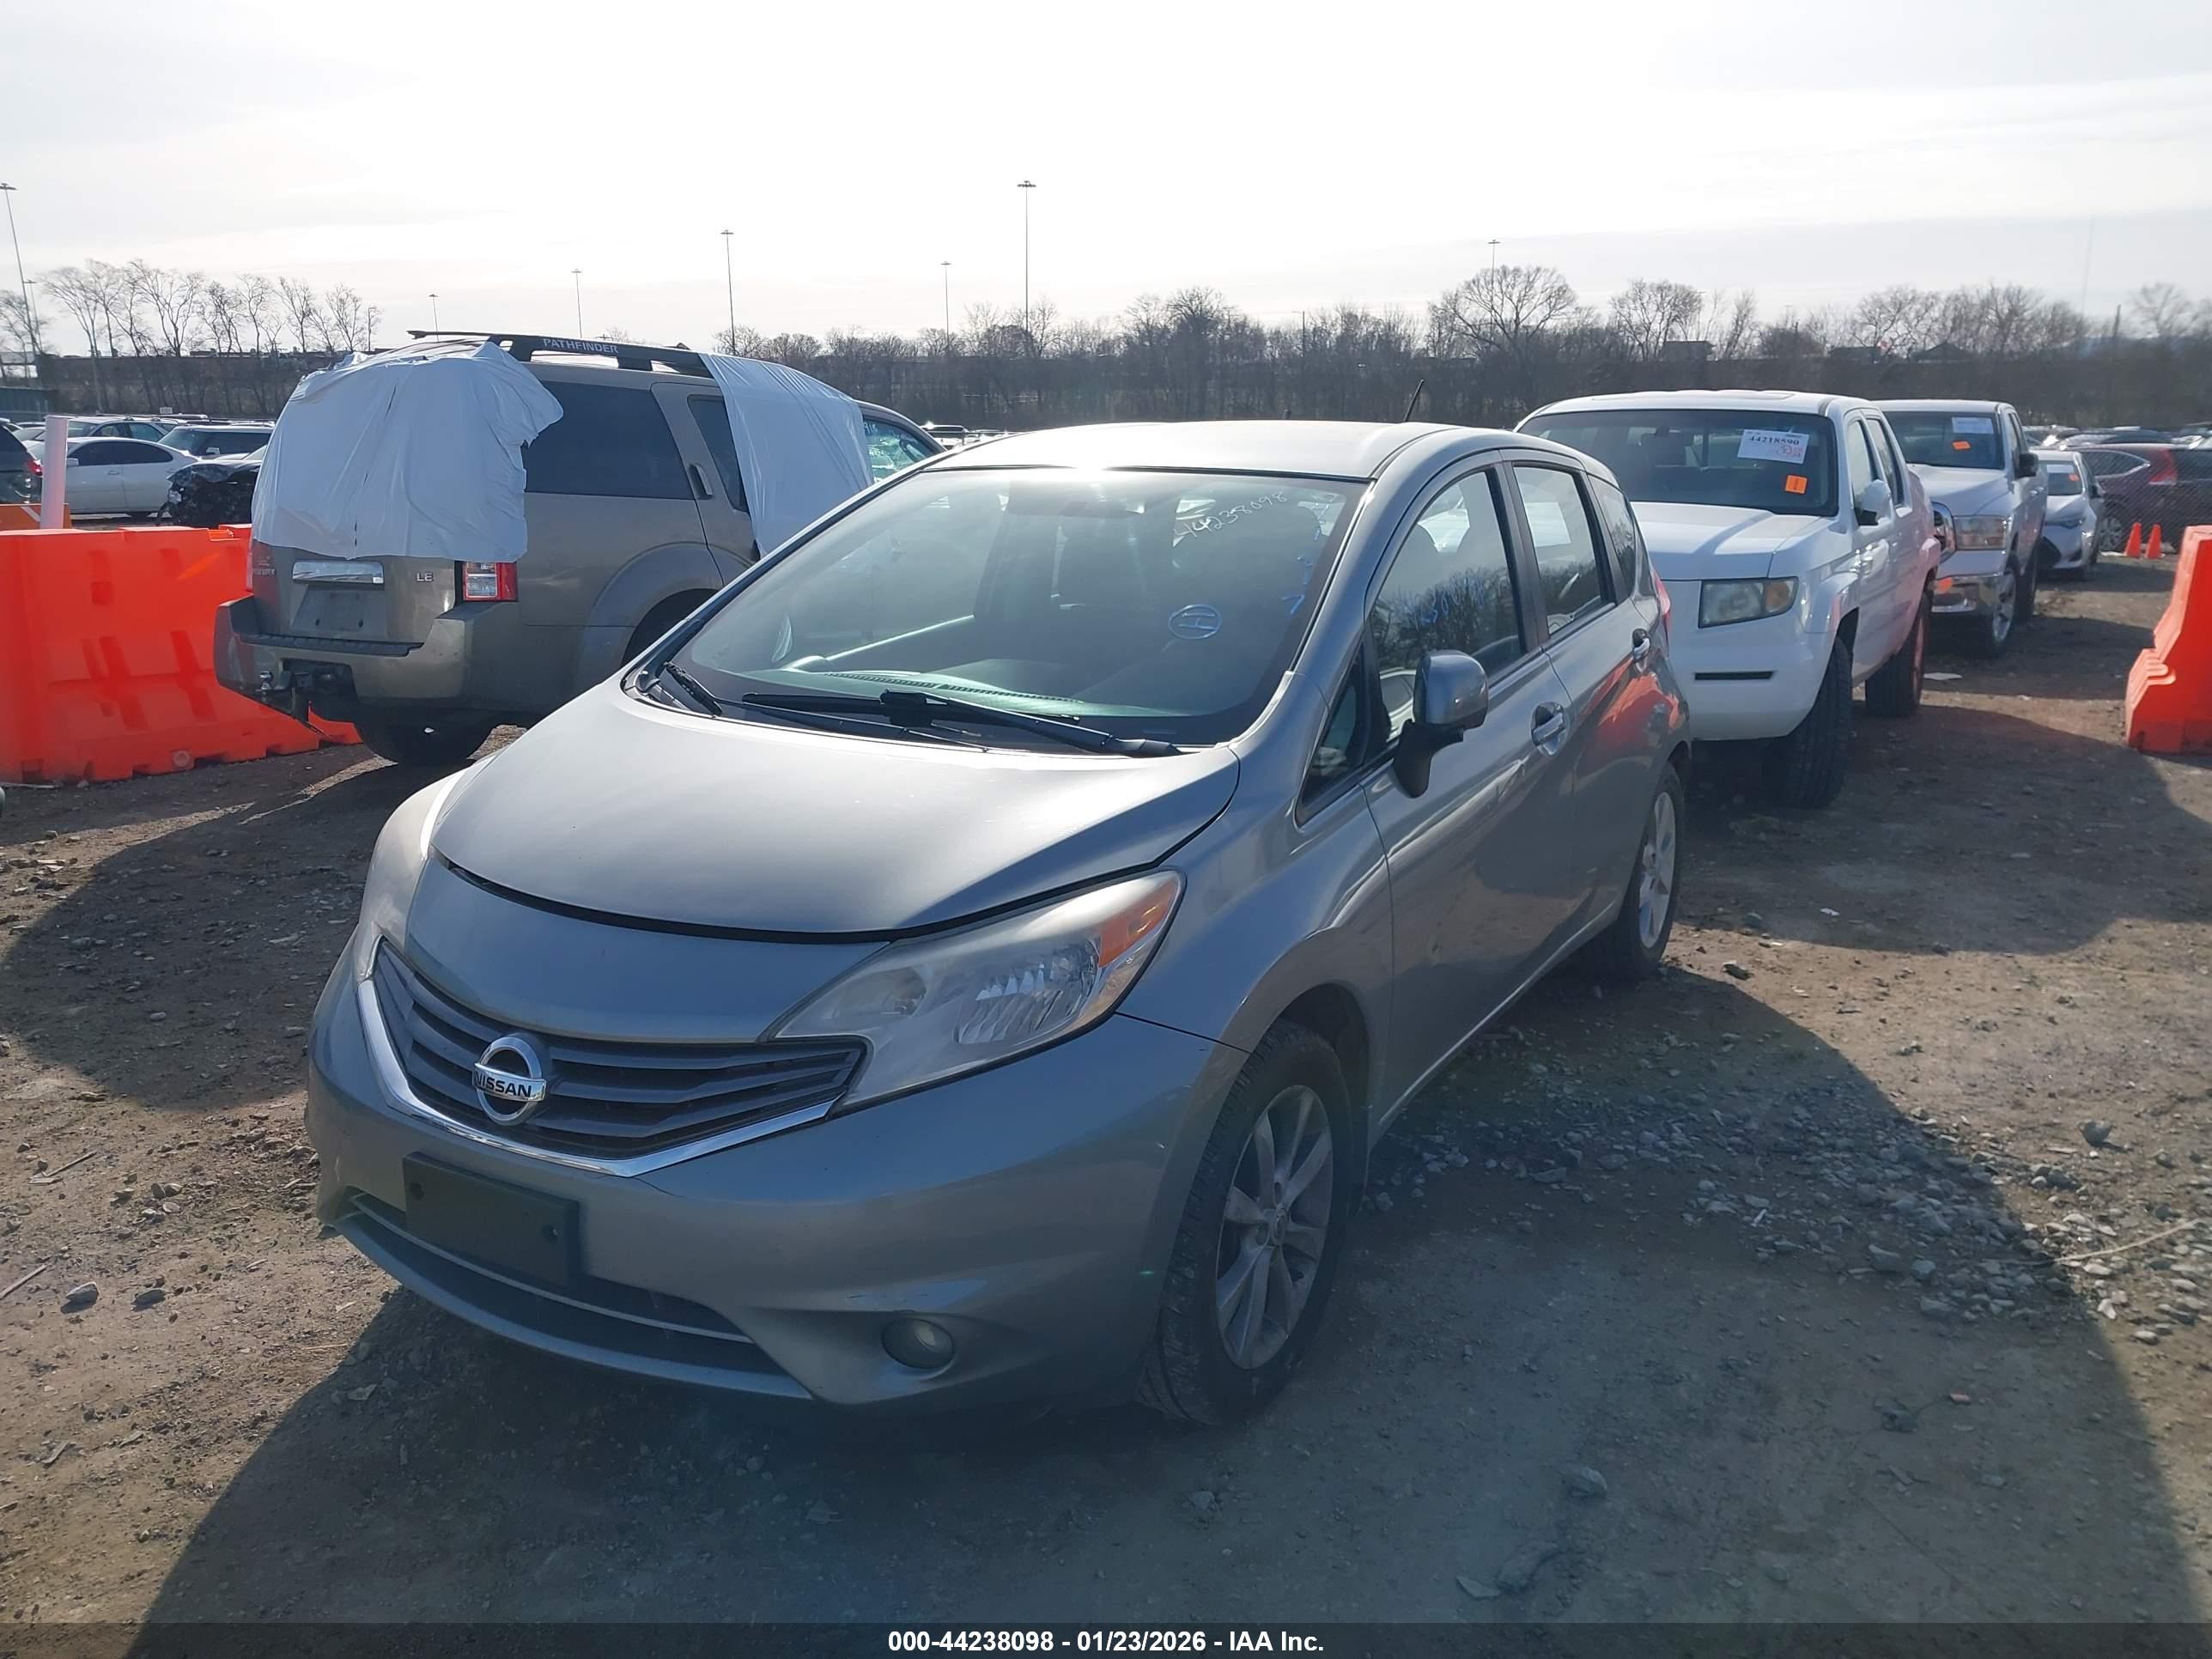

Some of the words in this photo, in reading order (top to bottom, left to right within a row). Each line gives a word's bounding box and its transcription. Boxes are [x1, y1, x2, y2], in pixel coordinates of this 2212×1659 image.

[543, 338, 618, 353] PATHFINDER
[1173, 491, 1287, 538] 44238098
[416, 572, 433, 581] LE
[474, 1070, 532, 1098] NISSAN
